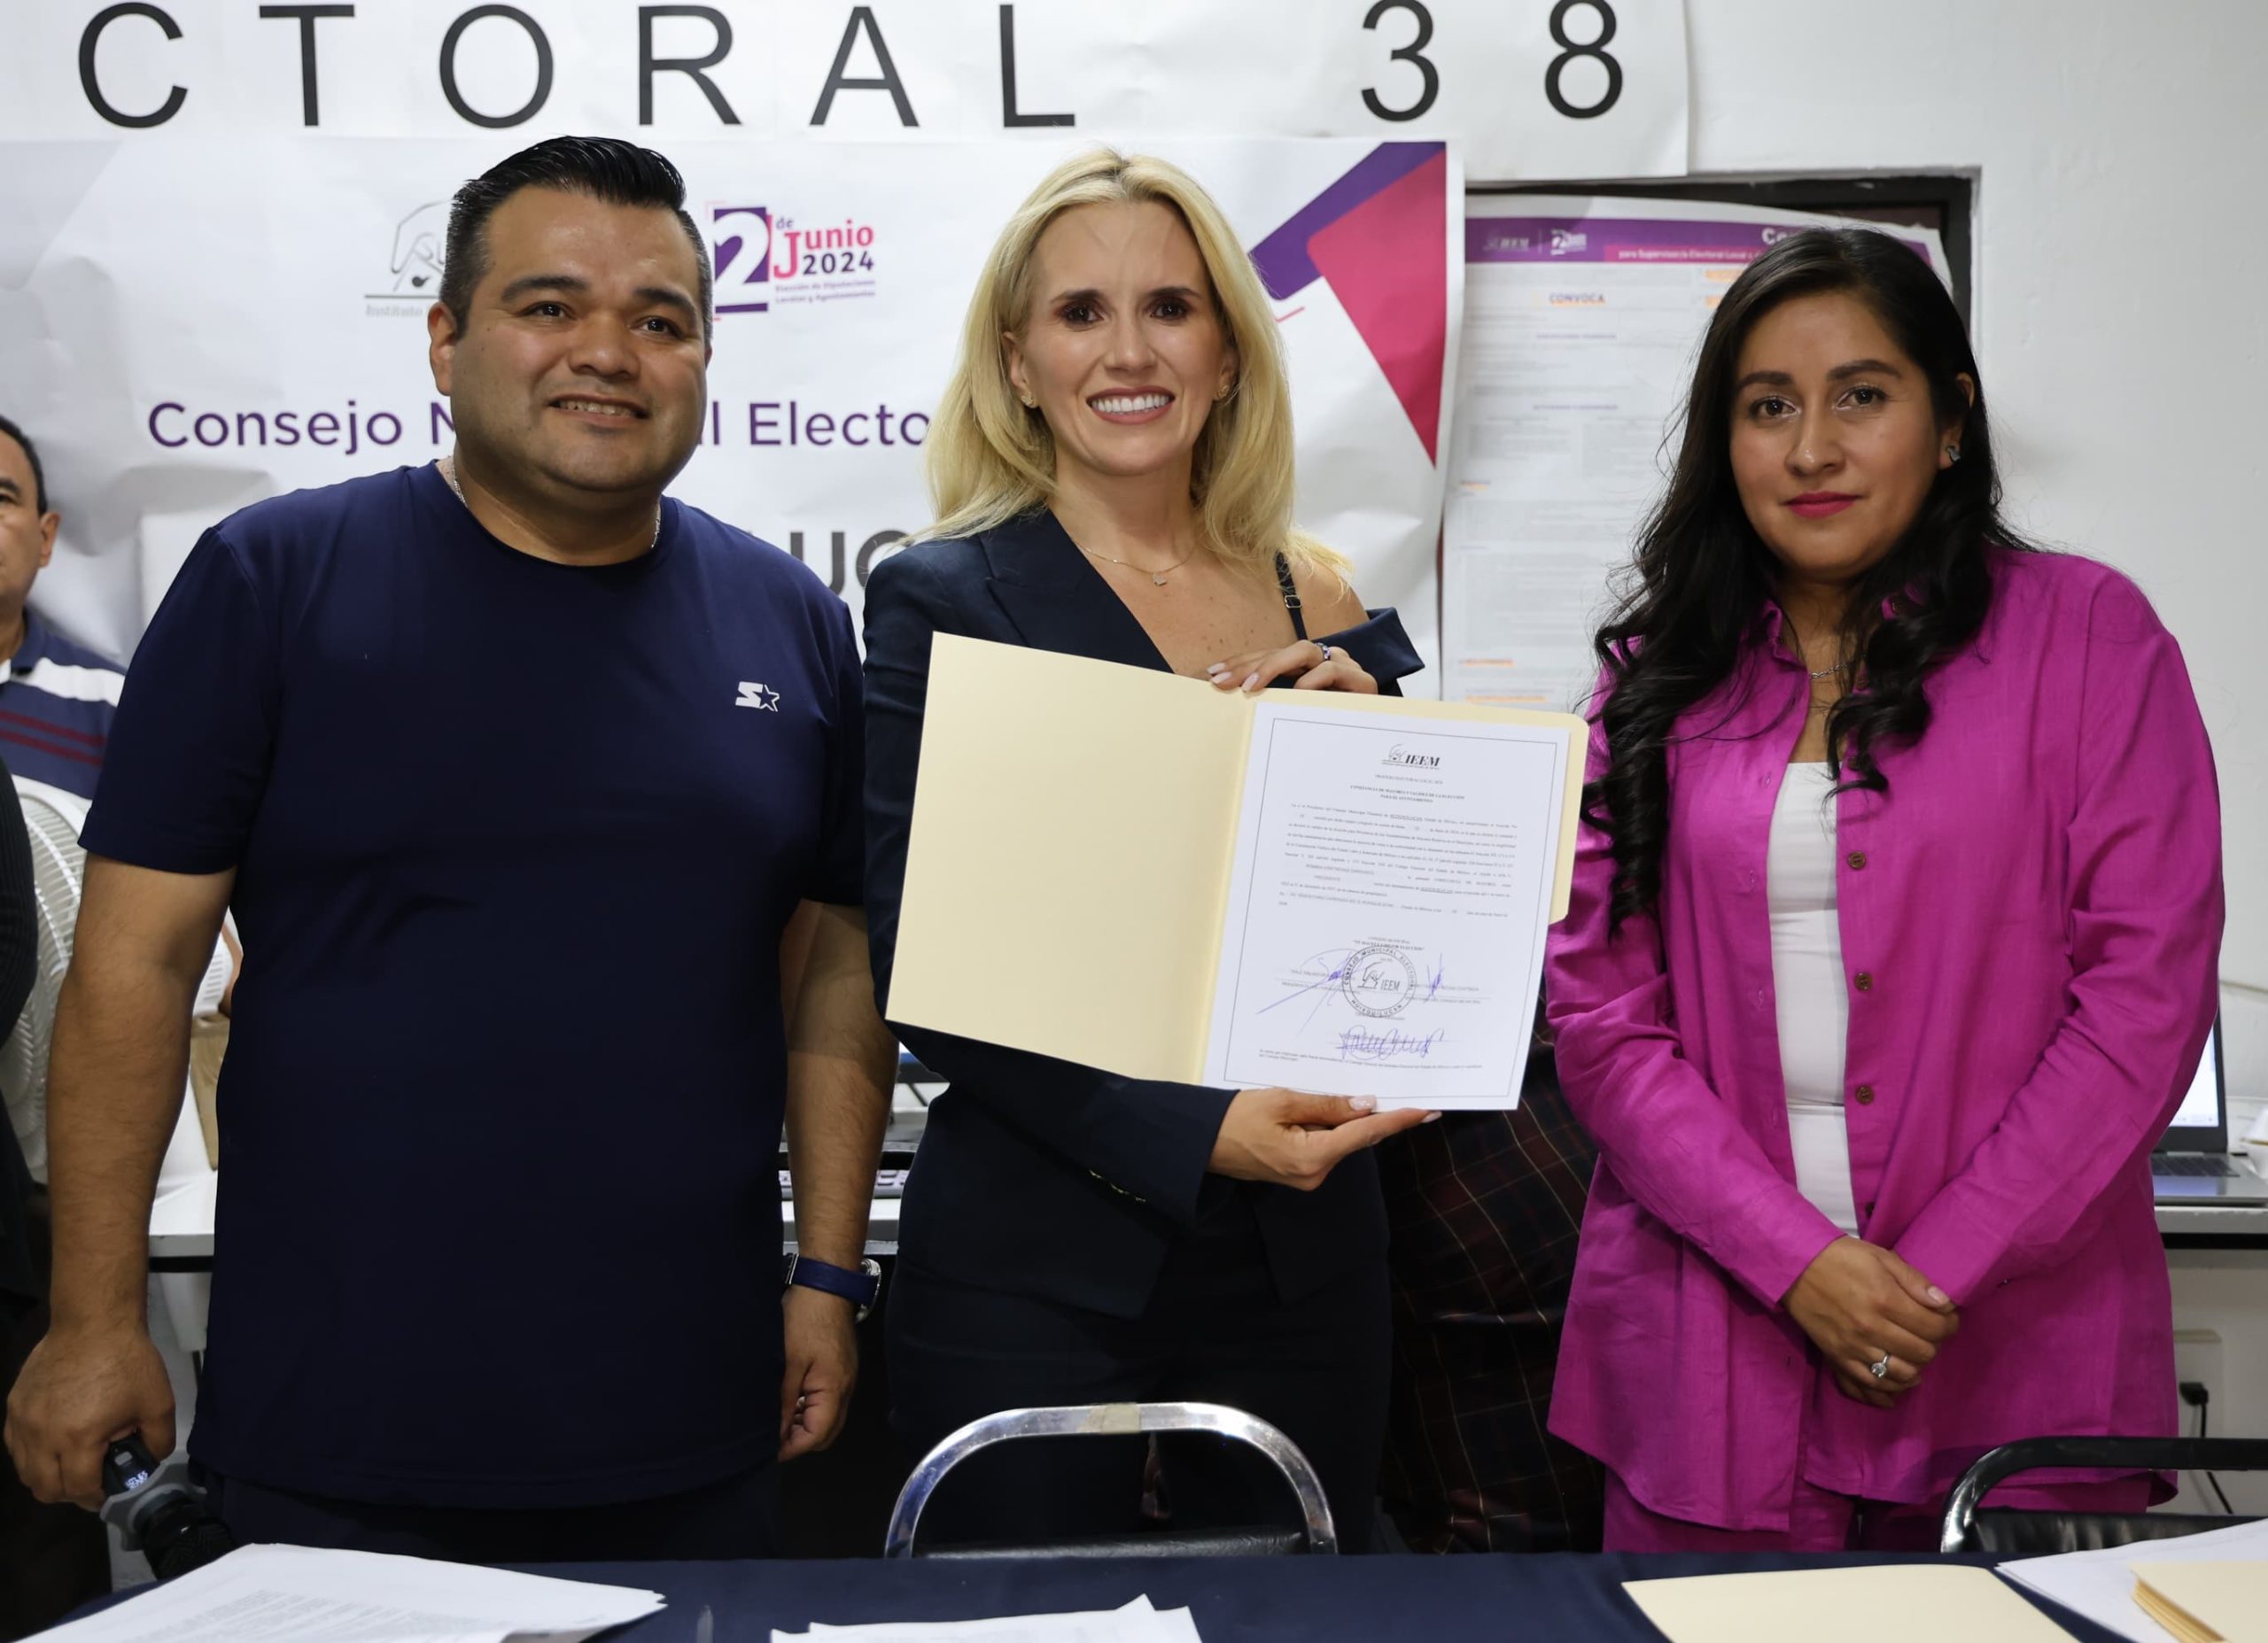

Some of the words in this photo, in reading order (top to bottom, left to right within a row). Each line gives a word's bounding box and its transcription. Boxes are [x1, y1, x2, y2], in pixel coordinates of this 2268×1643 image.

[1361, 0, 1623, 122] 38
[776, 218, 794, 230] de
[773, 219, 874, 279] Junio
[803, 251, 874, 275] 2024
[148, 400, 403, 455] Consejo
[1361, 947, 1397, 956] MUNICIPAL
[1381, 980, 1401, 991] IEEM
